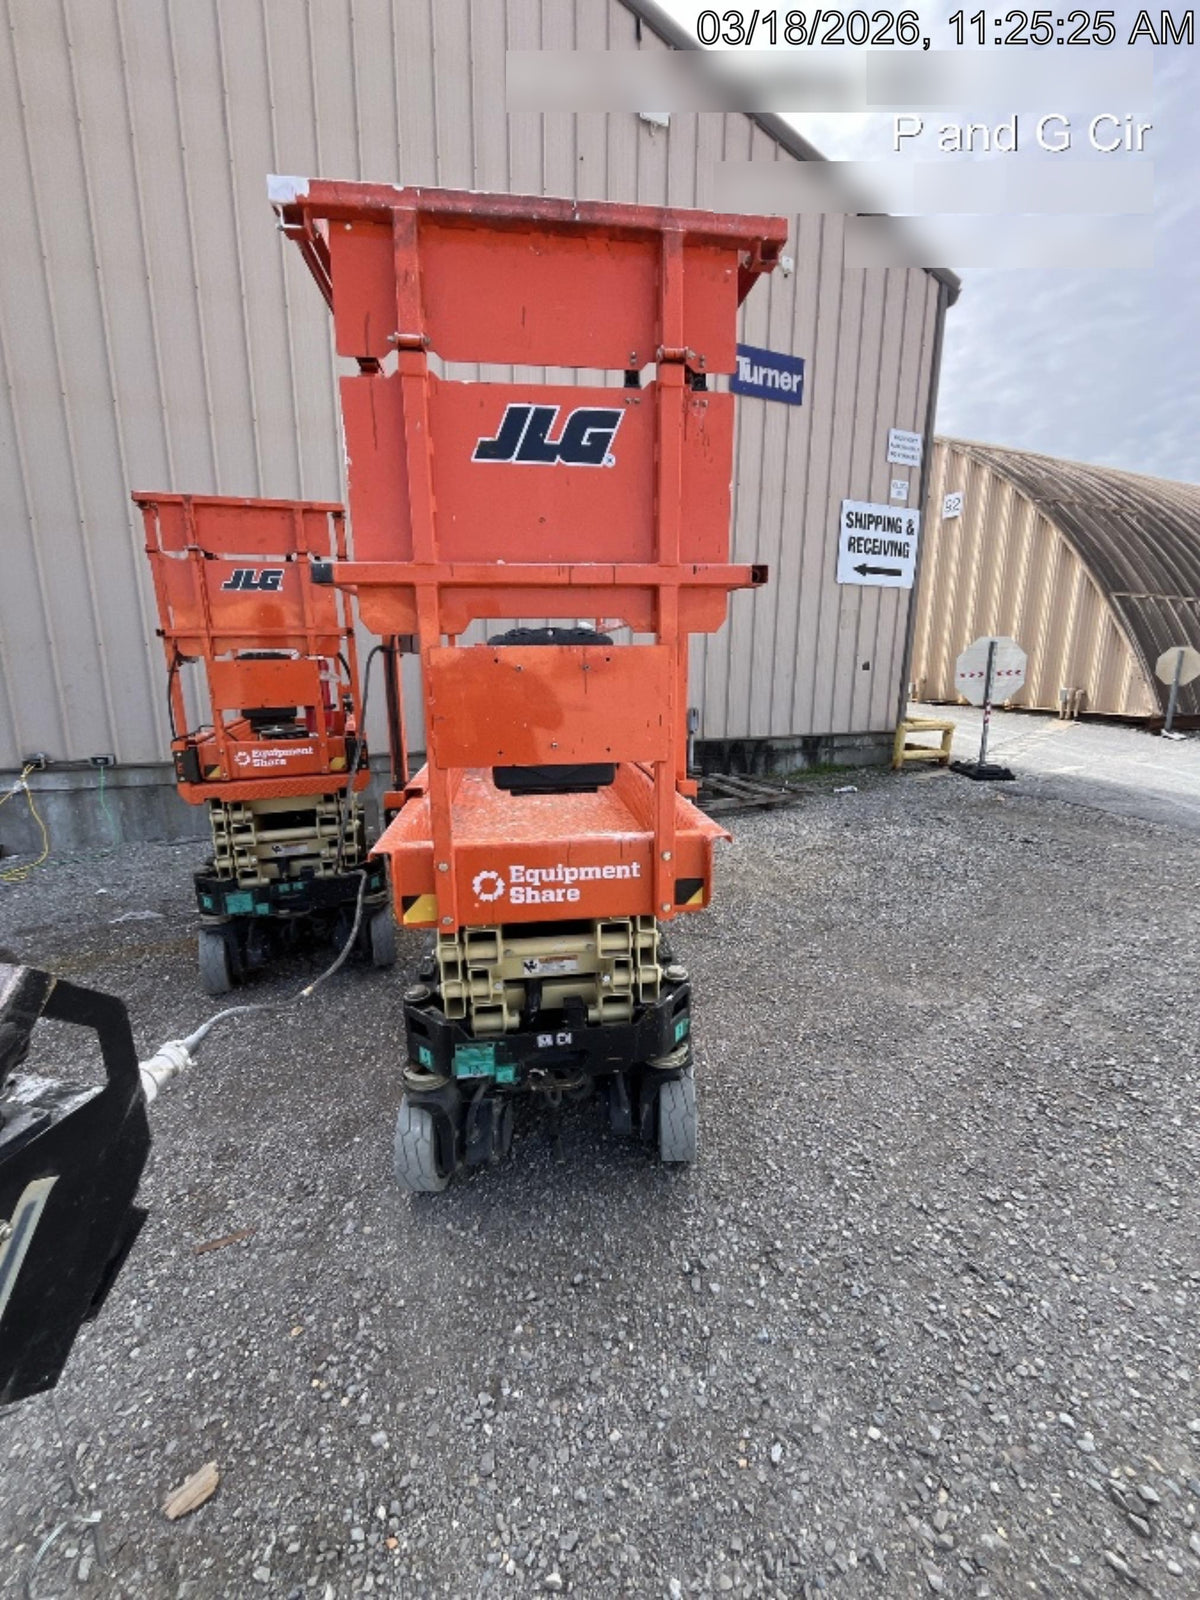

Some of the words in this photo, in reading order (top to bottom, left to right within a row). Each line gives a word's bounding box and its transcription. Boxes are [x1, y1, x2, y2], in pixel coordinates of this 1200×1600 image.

[736, 355, 802, 393] Turner
[471, 403, 626, 467] JLG
[845, 511, 903, 534] SHIPPING
[906, 518, 915, 536] &
[847, 536, 911, 559] RECEIVING
[221, 568, 285, 592] JLG
[251, 746, 314, 759] Equipment
[252, 758, 287, 767] Share
[509, 862, 641, 884] Equipment
[510, 886, 580, 904] Share
